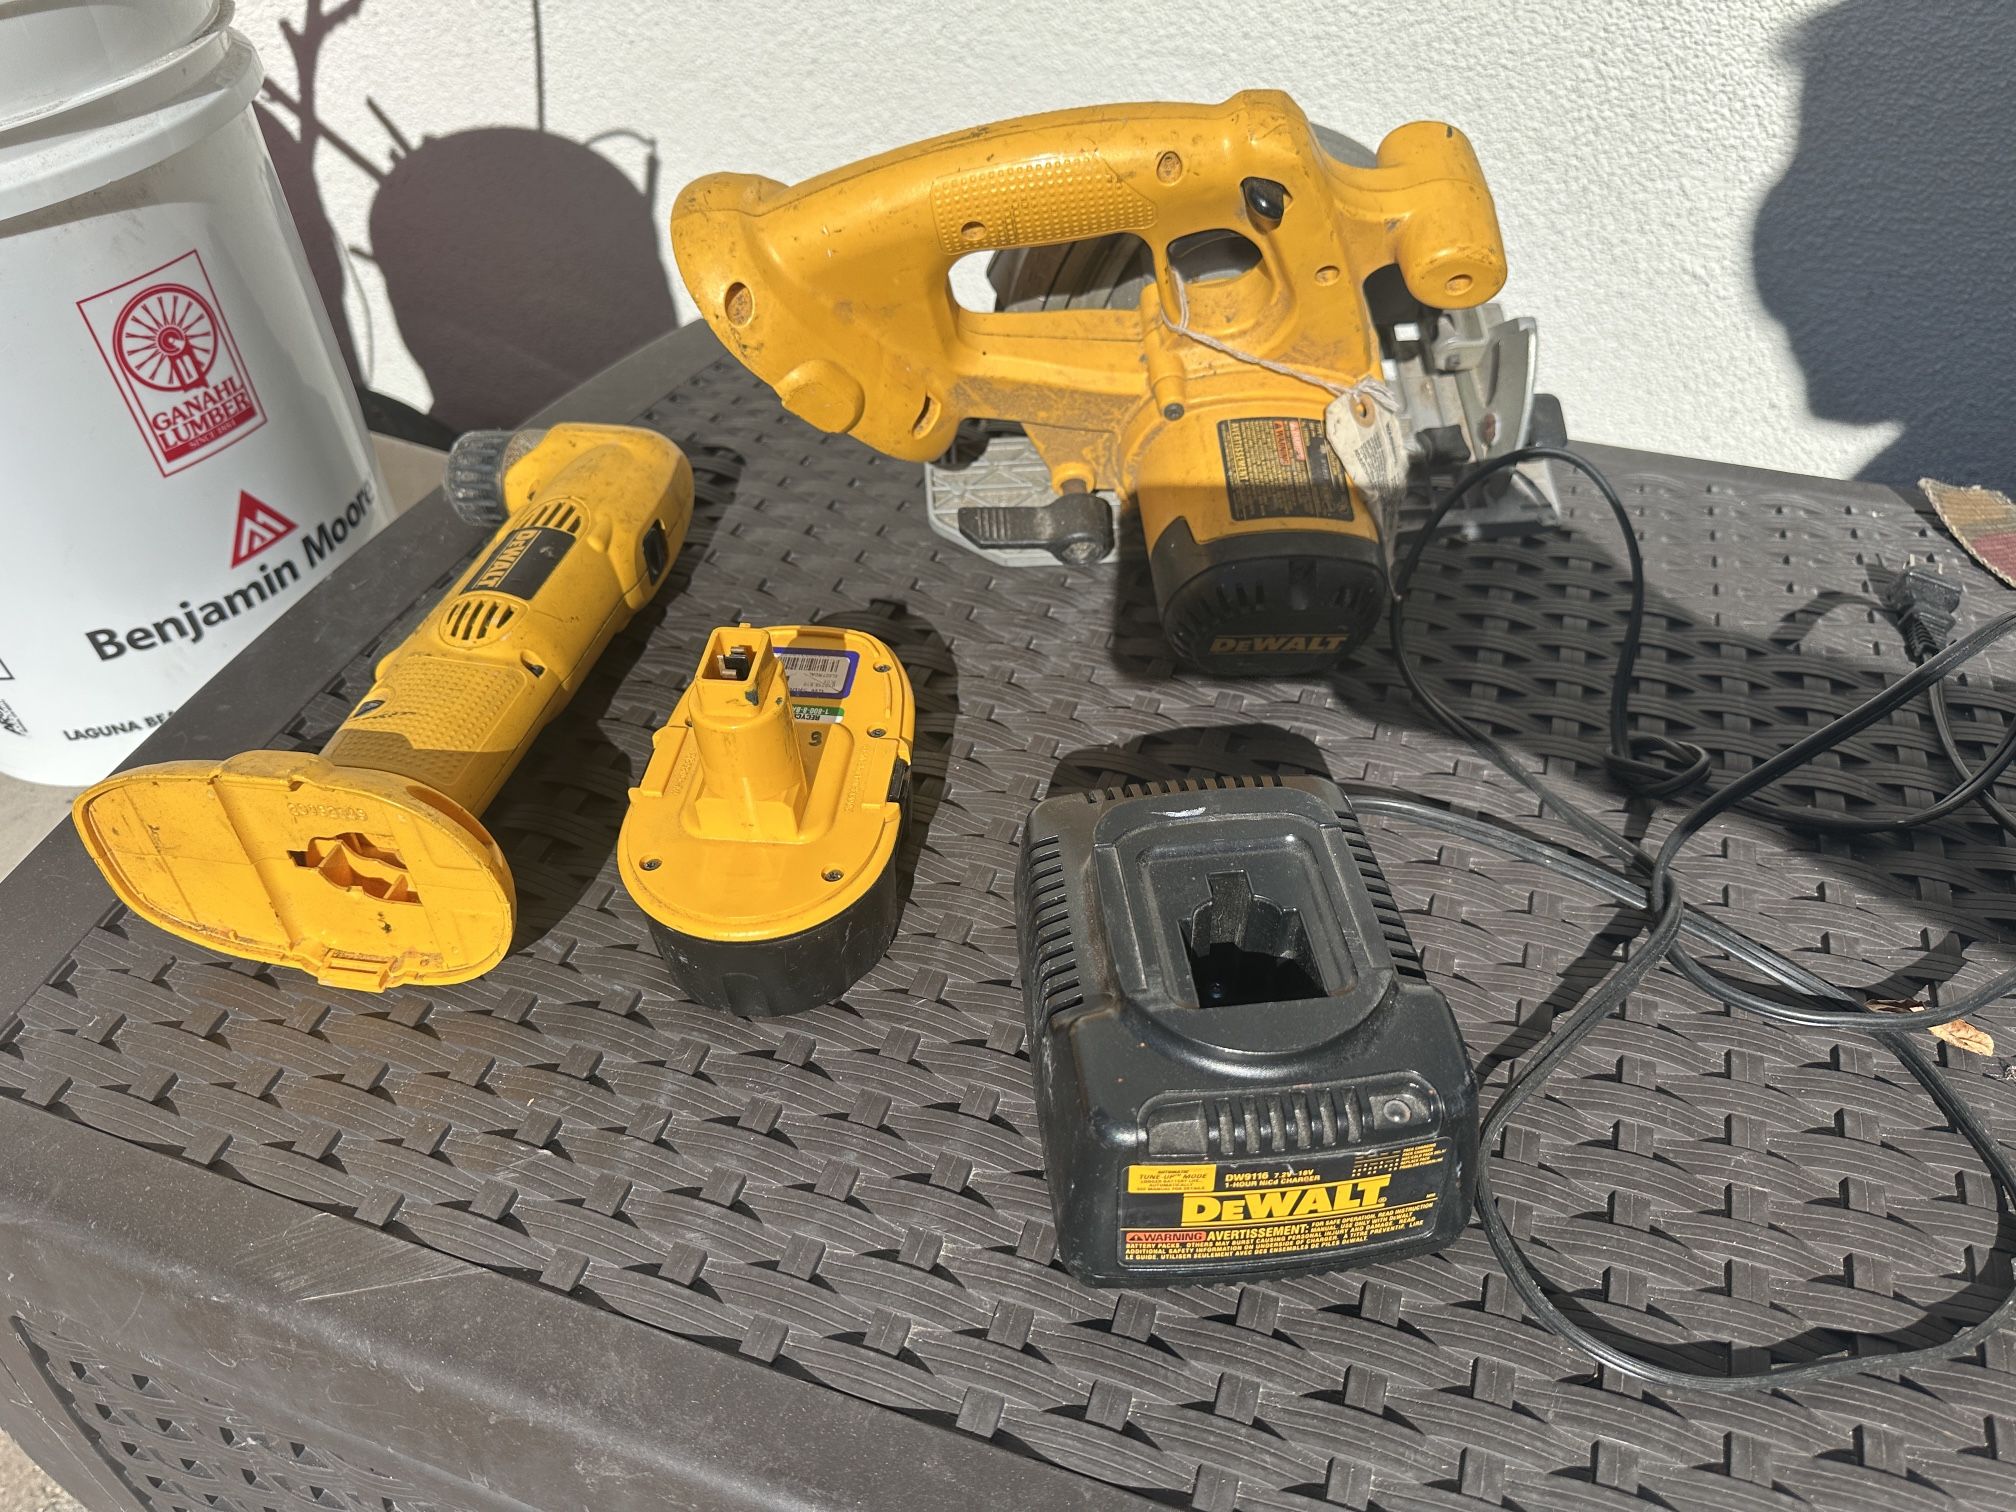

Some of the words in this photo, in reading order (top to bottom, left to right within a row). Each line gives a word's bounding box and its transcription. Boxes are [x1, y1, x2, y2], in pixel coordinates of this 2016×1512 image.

[152, 376, 246, 431] GANAHL
[160, 392, 250, 450] LUMBER
[85, 559, 301, 661] Benjamin
[300, 481, 376, 568] Moore
[63, 720, 142, 741] LAGUNA
[1224, 1172, 1269, 1182] DW9116
[1225, 1180, 1257, 1188] 1-HOUR
[1280, 1174, 1321, 1184] CHARGER
[1325, 1218, 1341, 1226] SAFE
[1378, 1209, 1394, 1218] READ
[1395, 1202, 1434, 1215] INSTRUCTION
[1354, 1219, 1371, 1227] ONLY
[1371, 1216, 1388, 1224] WITH
[1144, 1232, 1202, 1241] WARNING
[1196, 1245, 1243, 1253] INFORMATION
[1255, 1240, 1294, 1249] UNDERSIDE
[1350, 1230, 1369, 1238] TITRE
[1206, 1223, 1309, 1241] AVERTISSEMENT:
[1231, 1238, 1254, 1246] BURST
[1256, 1236, 1286, 1244] CAUSING
[1288, 1232, 1322, 1241] PERSONAL
[1324, 1228, 1349, 1237] INJURY
[1399, 1216, 1416, 1224] READ
[1193, 1251, 1233, 1259] SEULEMENT
[1269, 1244, 1309, 1253] ENSEMBLES
[1321, 1239, 1340, 1248] PILES
